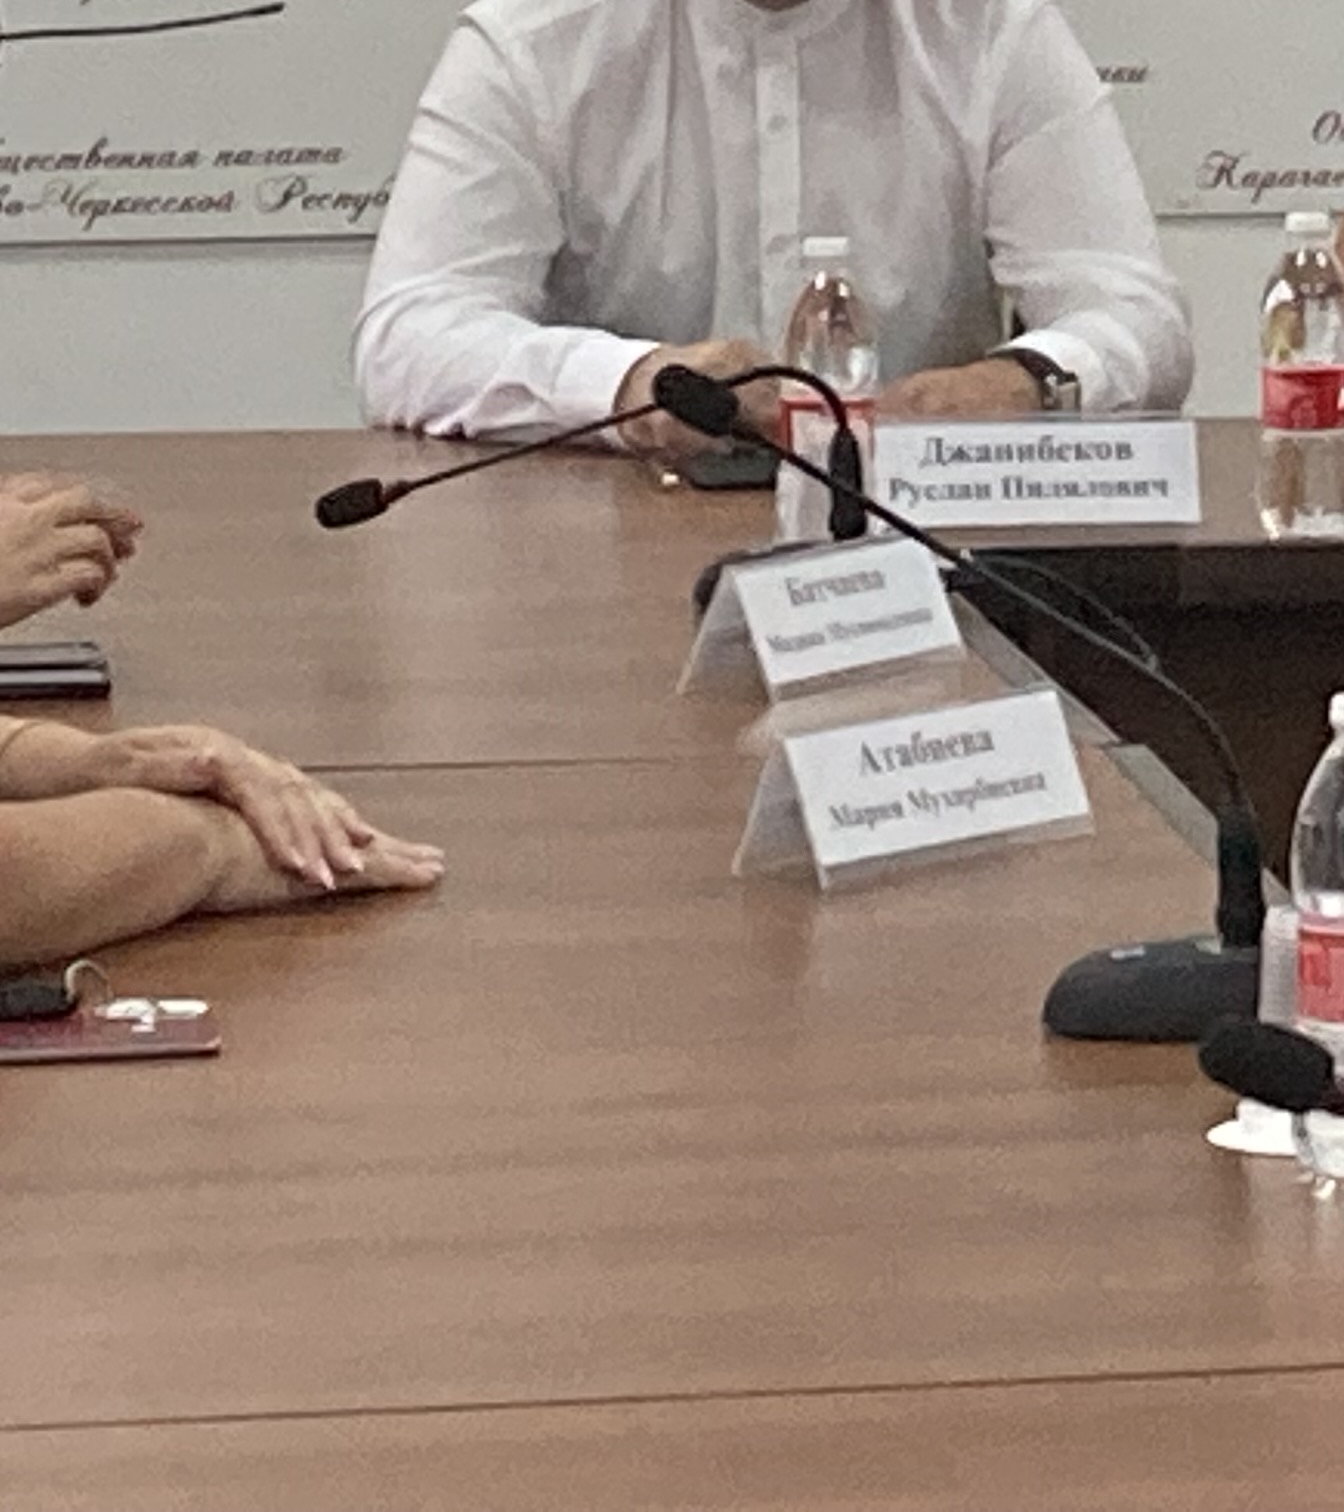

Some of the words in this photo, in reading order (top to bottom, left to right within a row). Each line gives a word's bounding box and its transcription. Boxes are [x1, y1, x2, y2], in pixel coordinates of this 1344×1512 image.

[212, 147, 345, 167] палата
[253, 183, 390, 229] Респуб
[918, 435, 1135, 468] Джанибеков
[889, 478, 992, 507] Руслан
